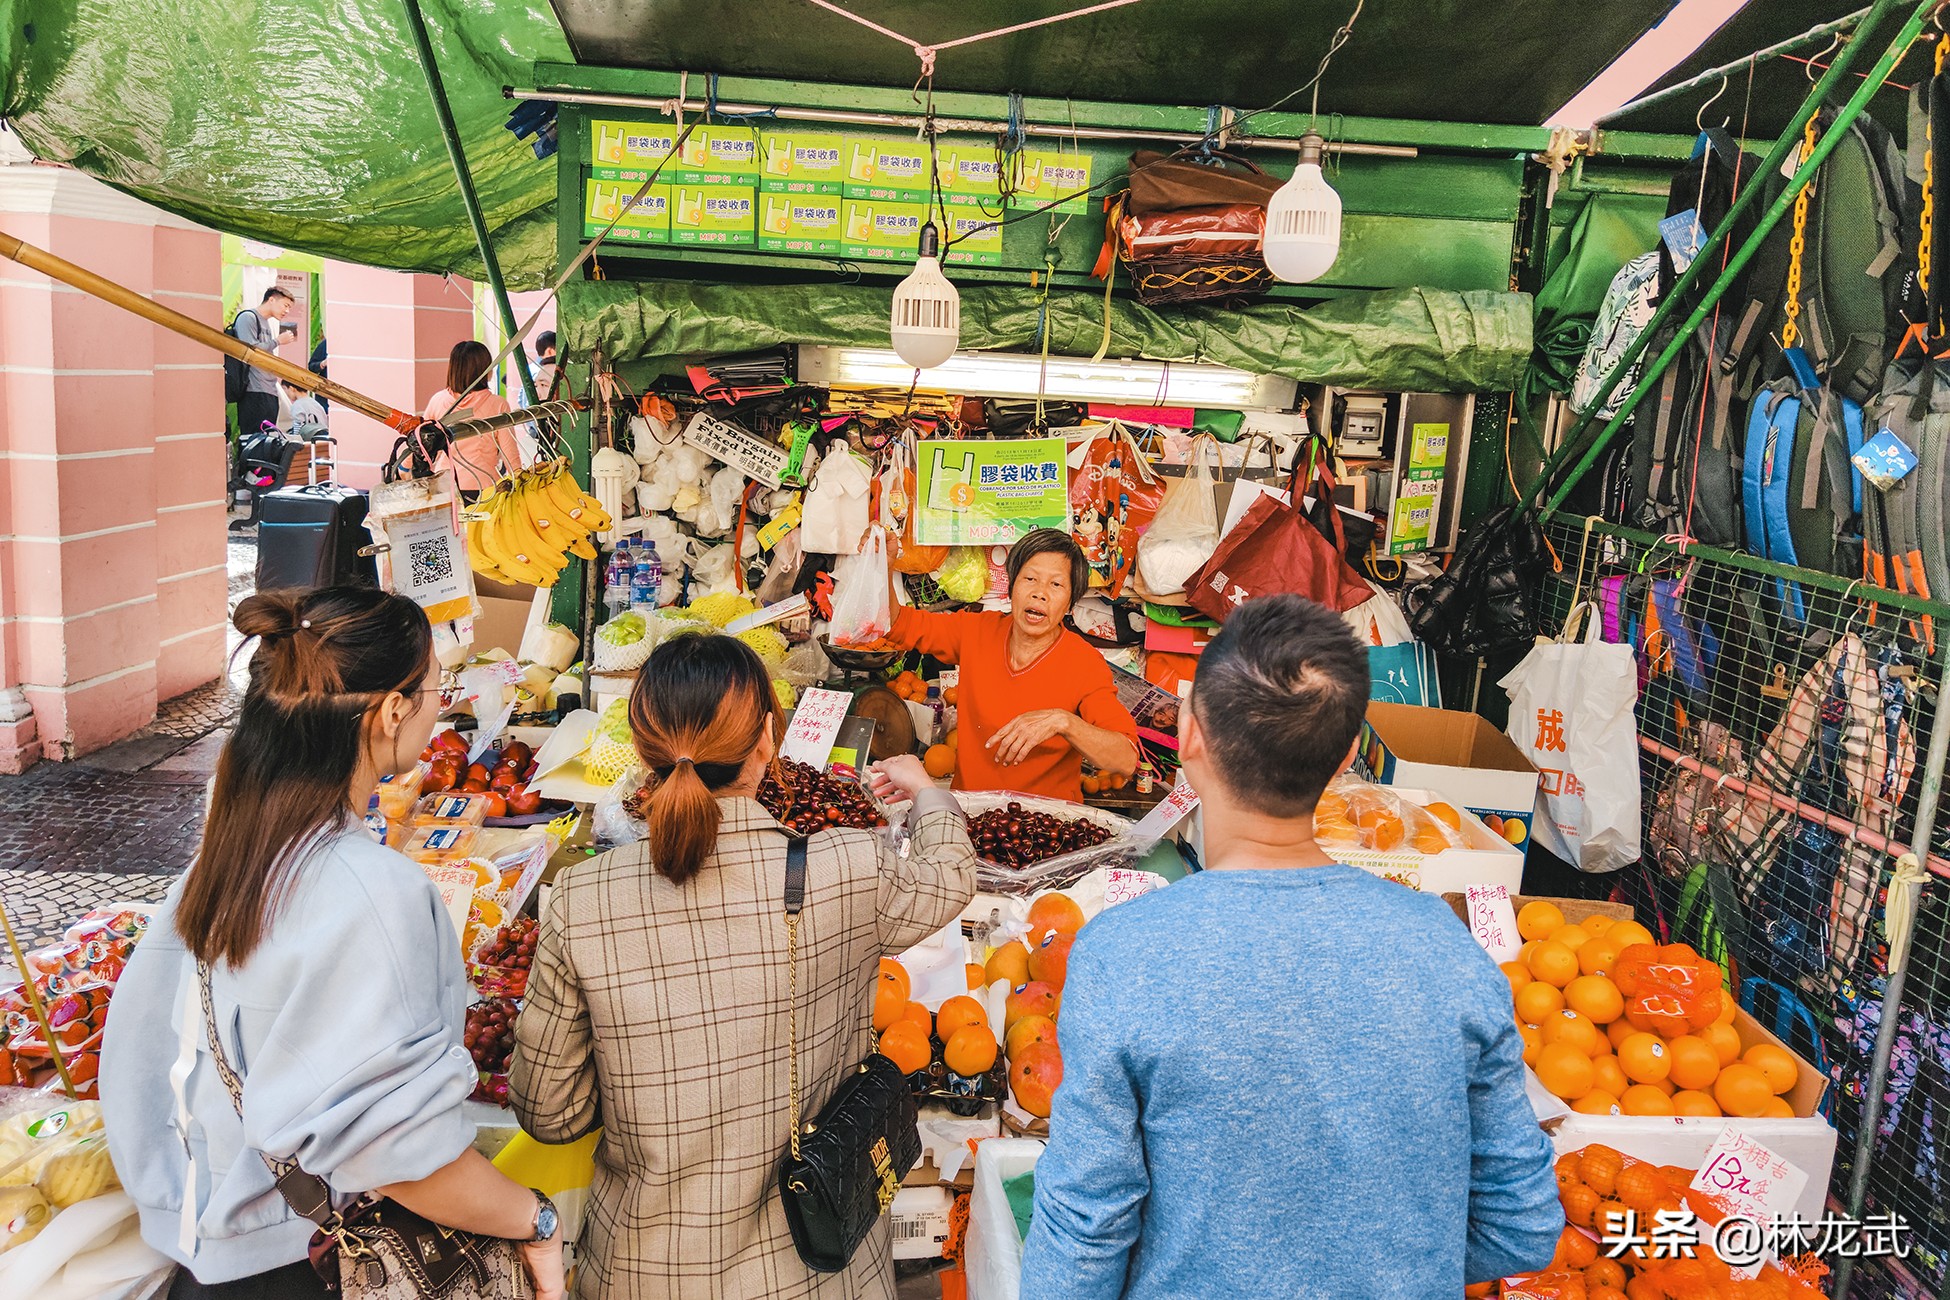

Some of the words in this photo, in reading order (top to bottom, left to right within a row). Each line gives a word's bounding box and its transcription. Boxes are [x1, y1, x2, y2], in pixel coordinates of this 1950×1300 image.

[628, 136, 672, 150] 膠袋收費
[711, 140, 755, 152] 膠袋收費
[796, 148, 838, 160] 膠袋收費
[878, 154, 922, 168] 膠袋收費
[620, 172, 637, 180] MOP
[704, 174, 720, 184] MOP
[788, 183, 804, 192] MOP
[870, 190, 886, 198] MOP
[706, 200, 750, 211] 膠袋收費
[794, 207, 836, 220] 膠袋收費
[876, 214, 918, 228] 膠袋收費
[613, 228, 630, 237] MOP
[700, 233, 716, 241] MOP
[786, 241, 803, 250] MOP
[868, 249, 884, 257] MOP
[948, 253, 964, 261] MOP
[703, 416, 724, 431] No
[726, 429, 782, 462] Bargain
[696, 424, 738, 450] Fixed
[740, 448, 778, 471] Price
[981, 463, 1057, 483] 膠袋收費
[970, 526, 998, 538] MOP
[1002, 525, 1015, 538] $1
[868, 1136, 890, 1167] DIOR
